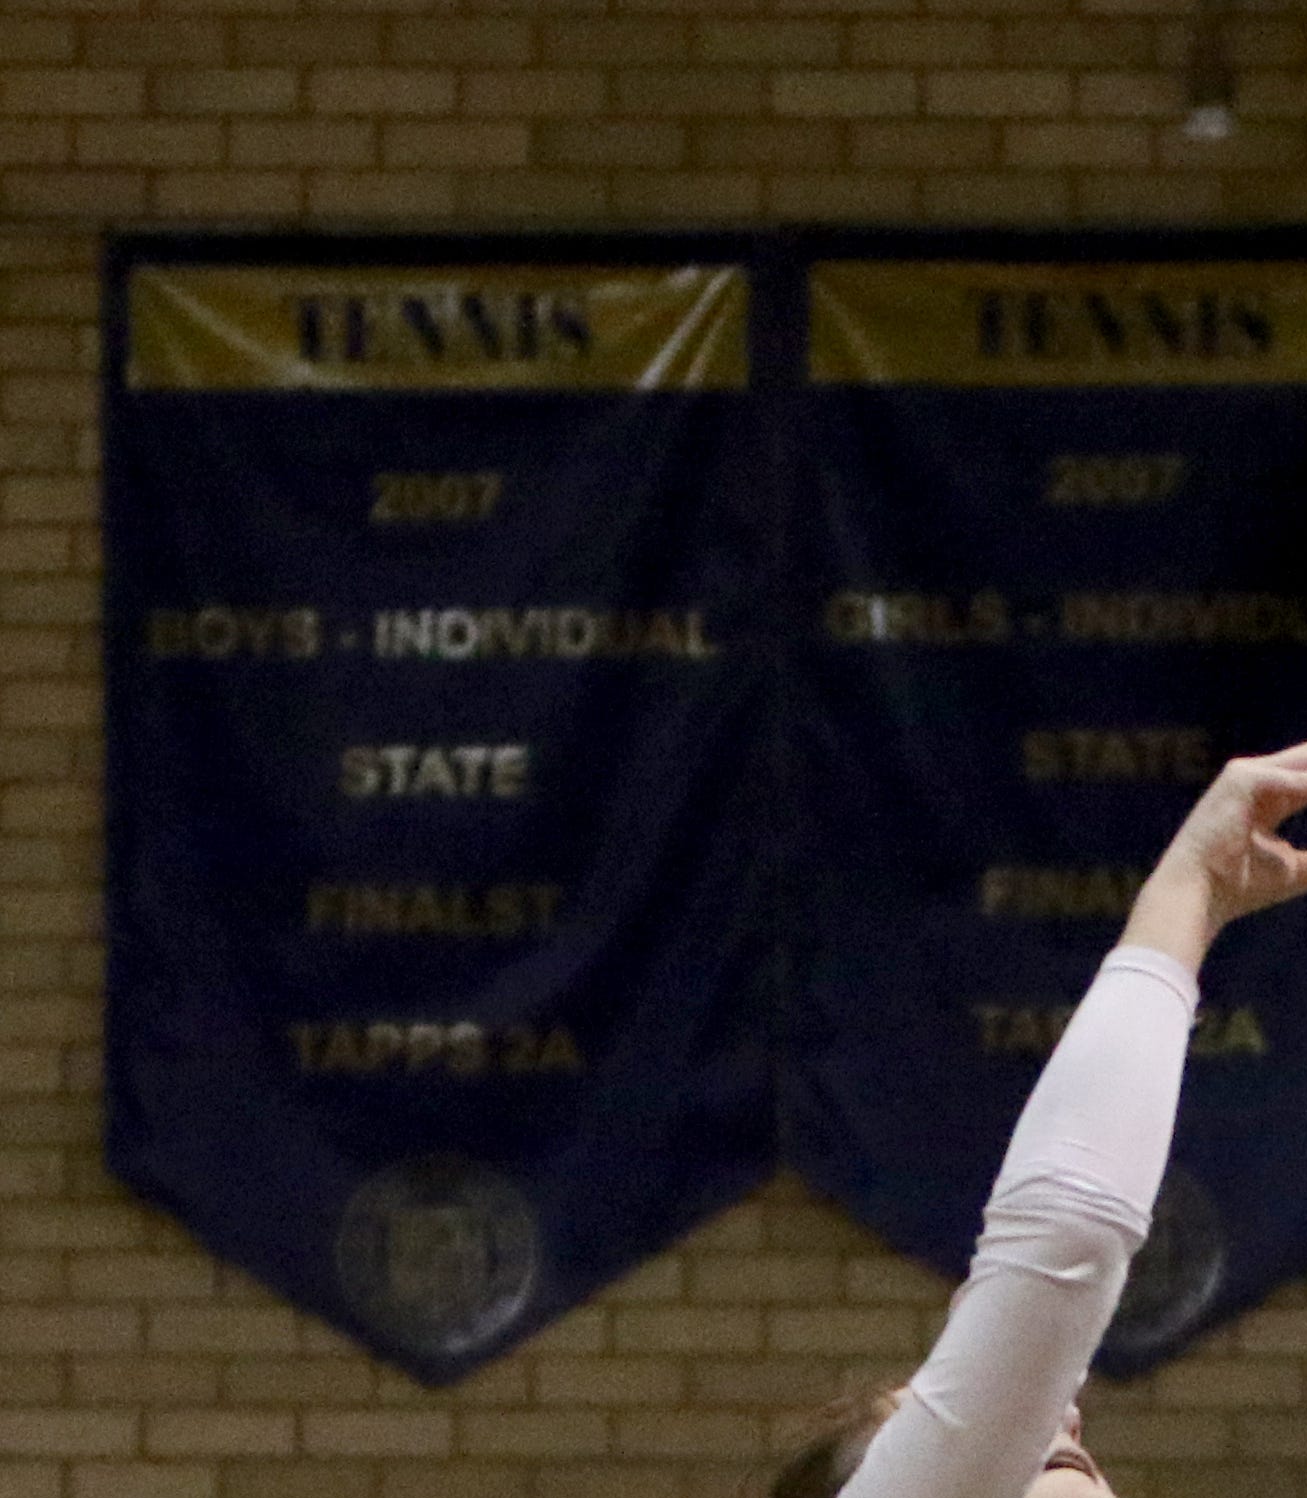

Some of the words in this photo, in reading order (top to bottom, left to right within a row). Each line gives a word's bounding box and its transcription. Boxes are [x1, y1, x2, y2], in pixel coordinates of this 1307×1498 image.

[290, 290, 592, 360] TENNIS
[976, 289, 1272, 357] TENNIS
[368, 473, 502, 522] 2007
[147, 608, 318, 658] BOYS
[375, 608, 716, 658] INDIVIDUAL
[828, 592, 1004, 643] GIRLS
[341, 744, 529, 798] STATE
[1023, 730, 1208, 780] STATE
[306, 885, 564, 936] FINALIST
[290, 1020, 486, 1075] TAPPS
[500, 1024, 587, 1075] 2A
